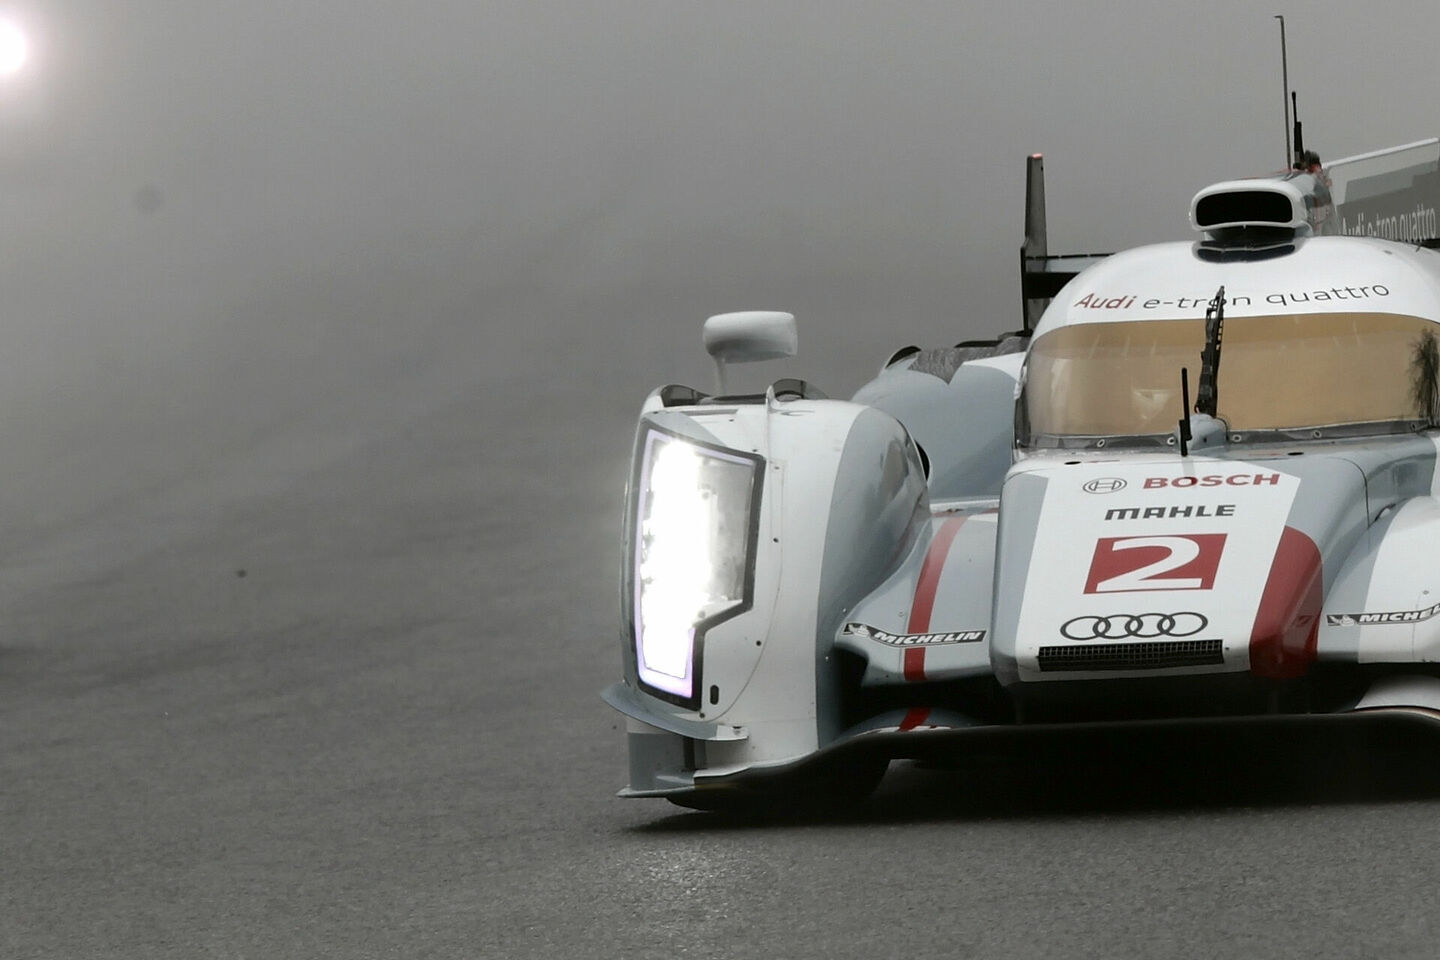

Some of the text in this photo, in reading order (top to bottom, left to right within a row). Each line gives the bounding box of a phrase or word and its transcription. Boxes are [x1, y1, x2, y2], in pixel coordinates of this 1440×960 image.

[1074, 283, 1391, 310] Audi e-tron quattro
[1142, 473, 1281, 490] BOSCH
[1104, 504, 1237, 521] MAHLE
[1095, 536, 1203, 593] 2
[873, 630, 983, 645] MICHELIN
